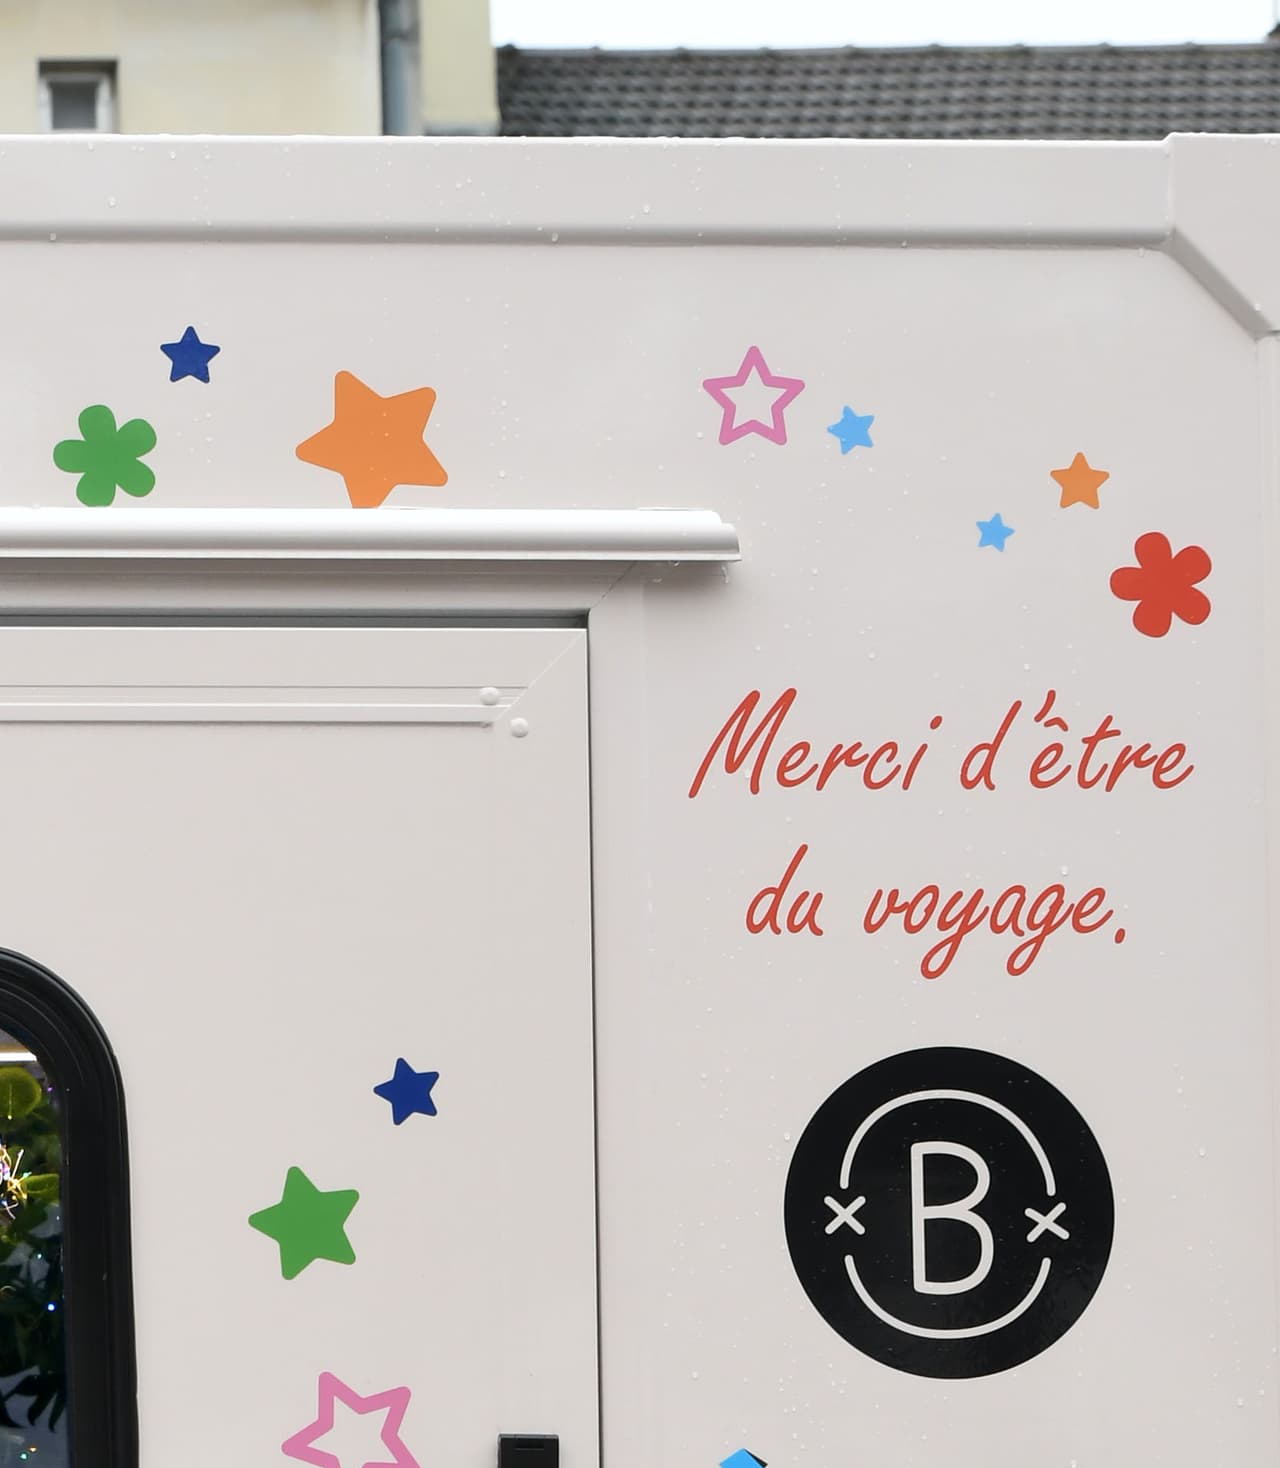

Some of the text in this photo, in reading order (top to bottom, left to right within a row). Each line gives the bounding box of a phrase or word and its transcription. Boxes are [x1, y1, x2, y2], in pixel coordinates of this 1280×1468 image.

[688, 688, 1195, 799] Merci d'être
[746, 844, 1127, 980] du voyage.
